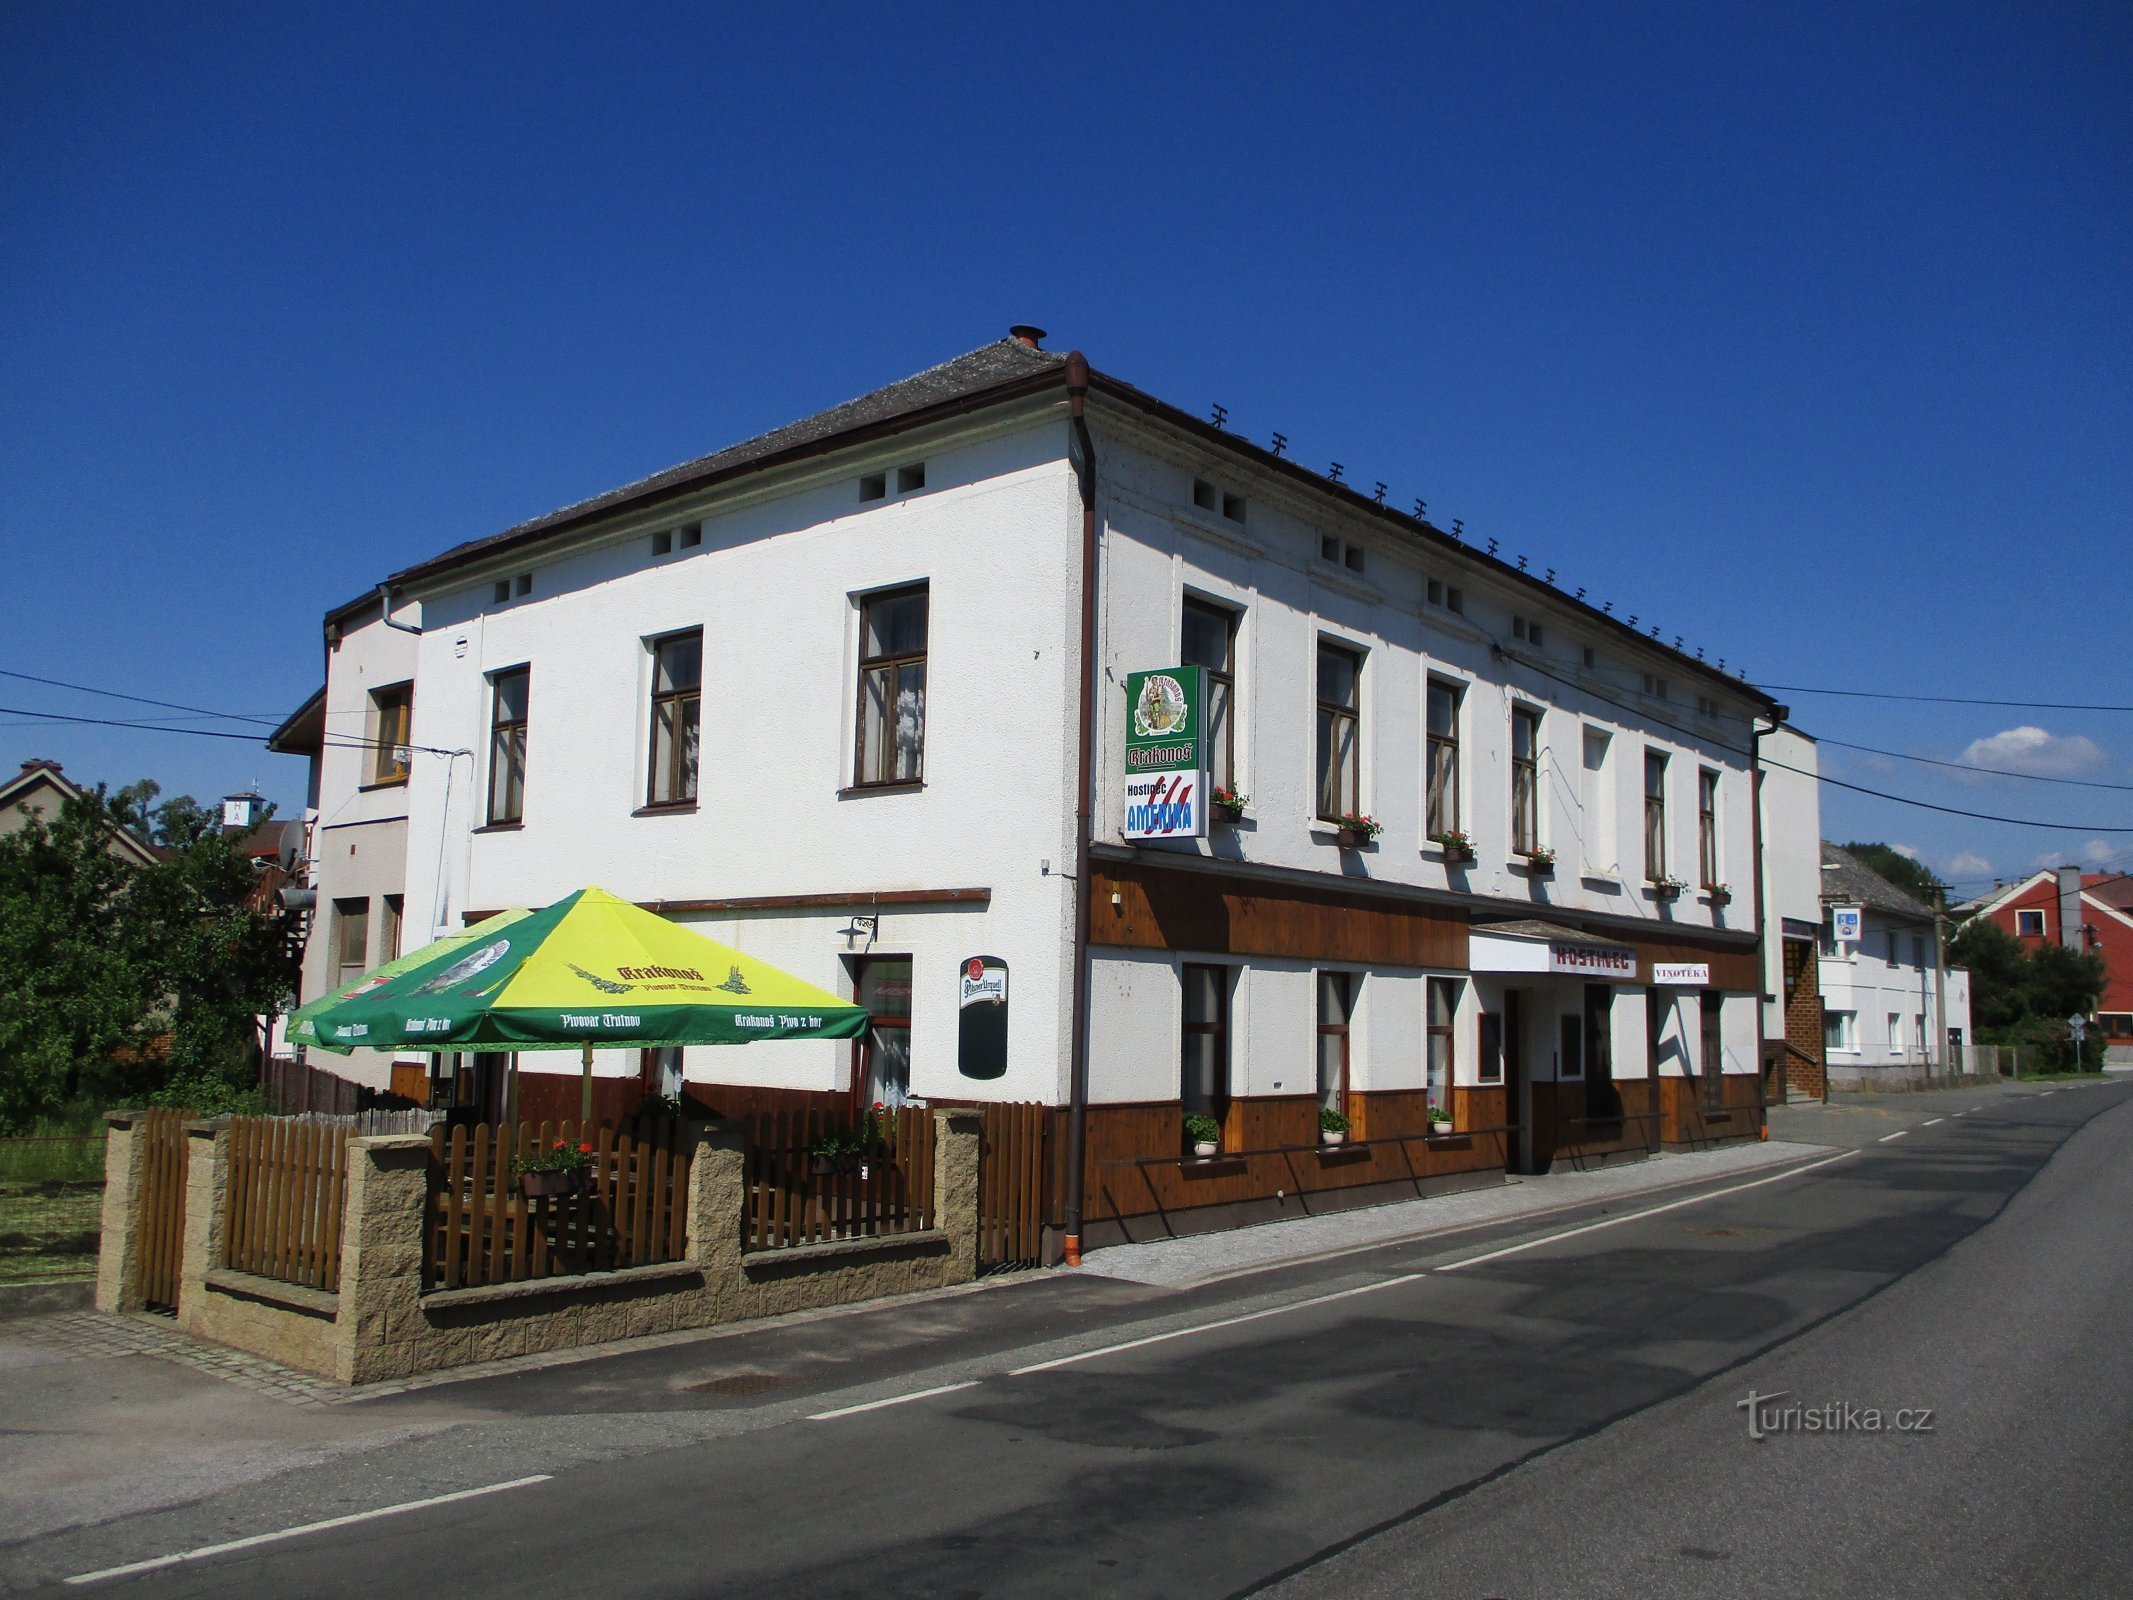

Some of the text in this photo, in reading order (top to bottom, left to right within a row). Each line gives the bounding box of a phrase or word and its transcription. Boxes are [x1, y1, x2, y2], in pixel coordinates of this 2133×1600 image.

[1128, 743, 1192, 766] Krakonoš
[1127, 783, 1167, 797] Hostinec
[1127, 802, 1192, 831] AMERIKA
[1556, 946, 1629, 970] HOSTINEC
[616, 964, 705, 981] Krakonoš
[641, 983, 712, 992] Pivovar Trutnov
[964, 980, 1002, 998] Pilsner Urquell
[560, 1013, 641, 1028] Pivovar Trutnov
[734, 1014, 823, 1029] Krakonoš Pivo z hor
